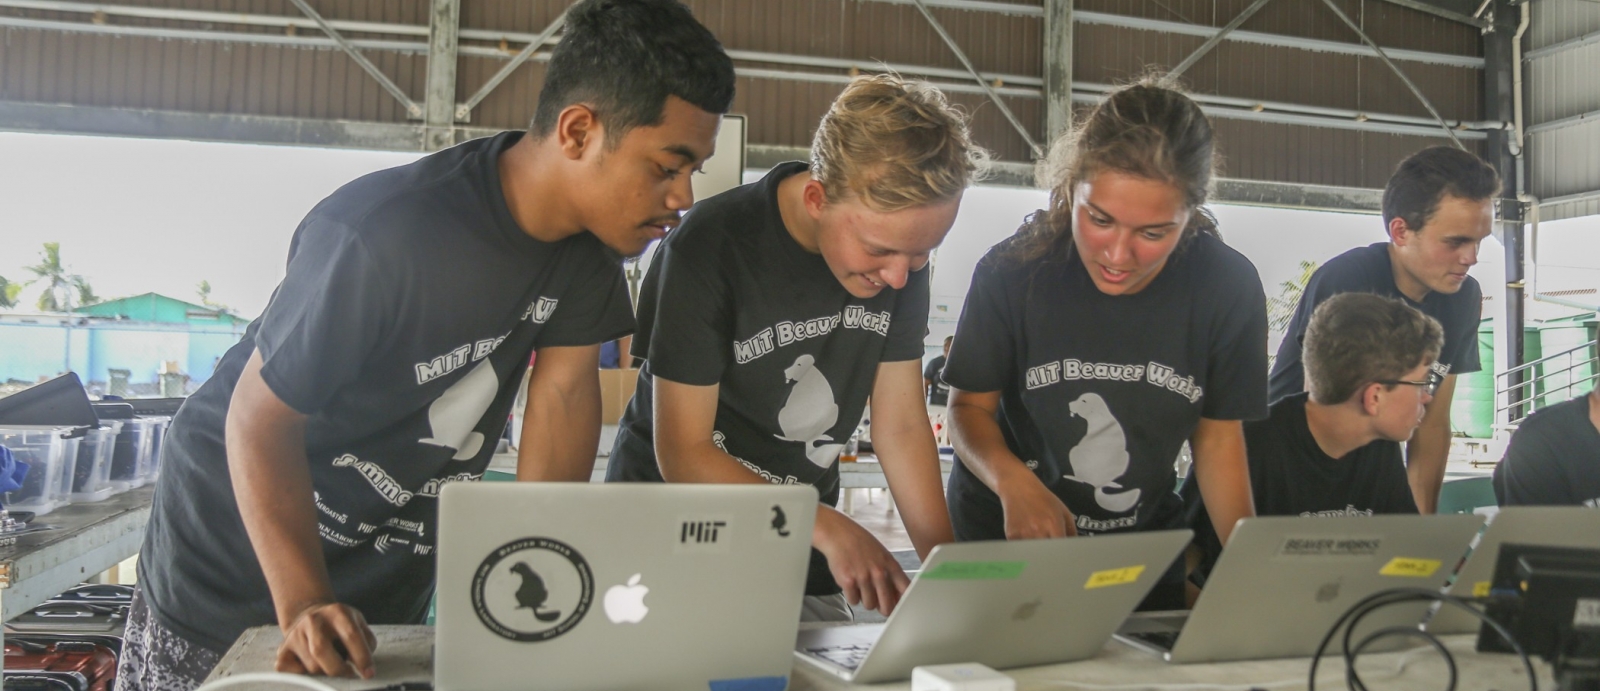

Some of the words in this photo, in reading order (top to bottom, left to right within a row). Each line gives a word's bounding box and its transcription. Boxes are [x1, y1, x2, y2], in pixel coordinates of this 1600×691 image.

[734, 327, 775, 364] MIT
[842, 305, 891, 337] Work
[415, 344, 471, 385] MIT
[1026, 361, 1060, 389] MIT
[1063, 359, 1145, 381] Beaver
[1147, 361, 1203, 403] Works
